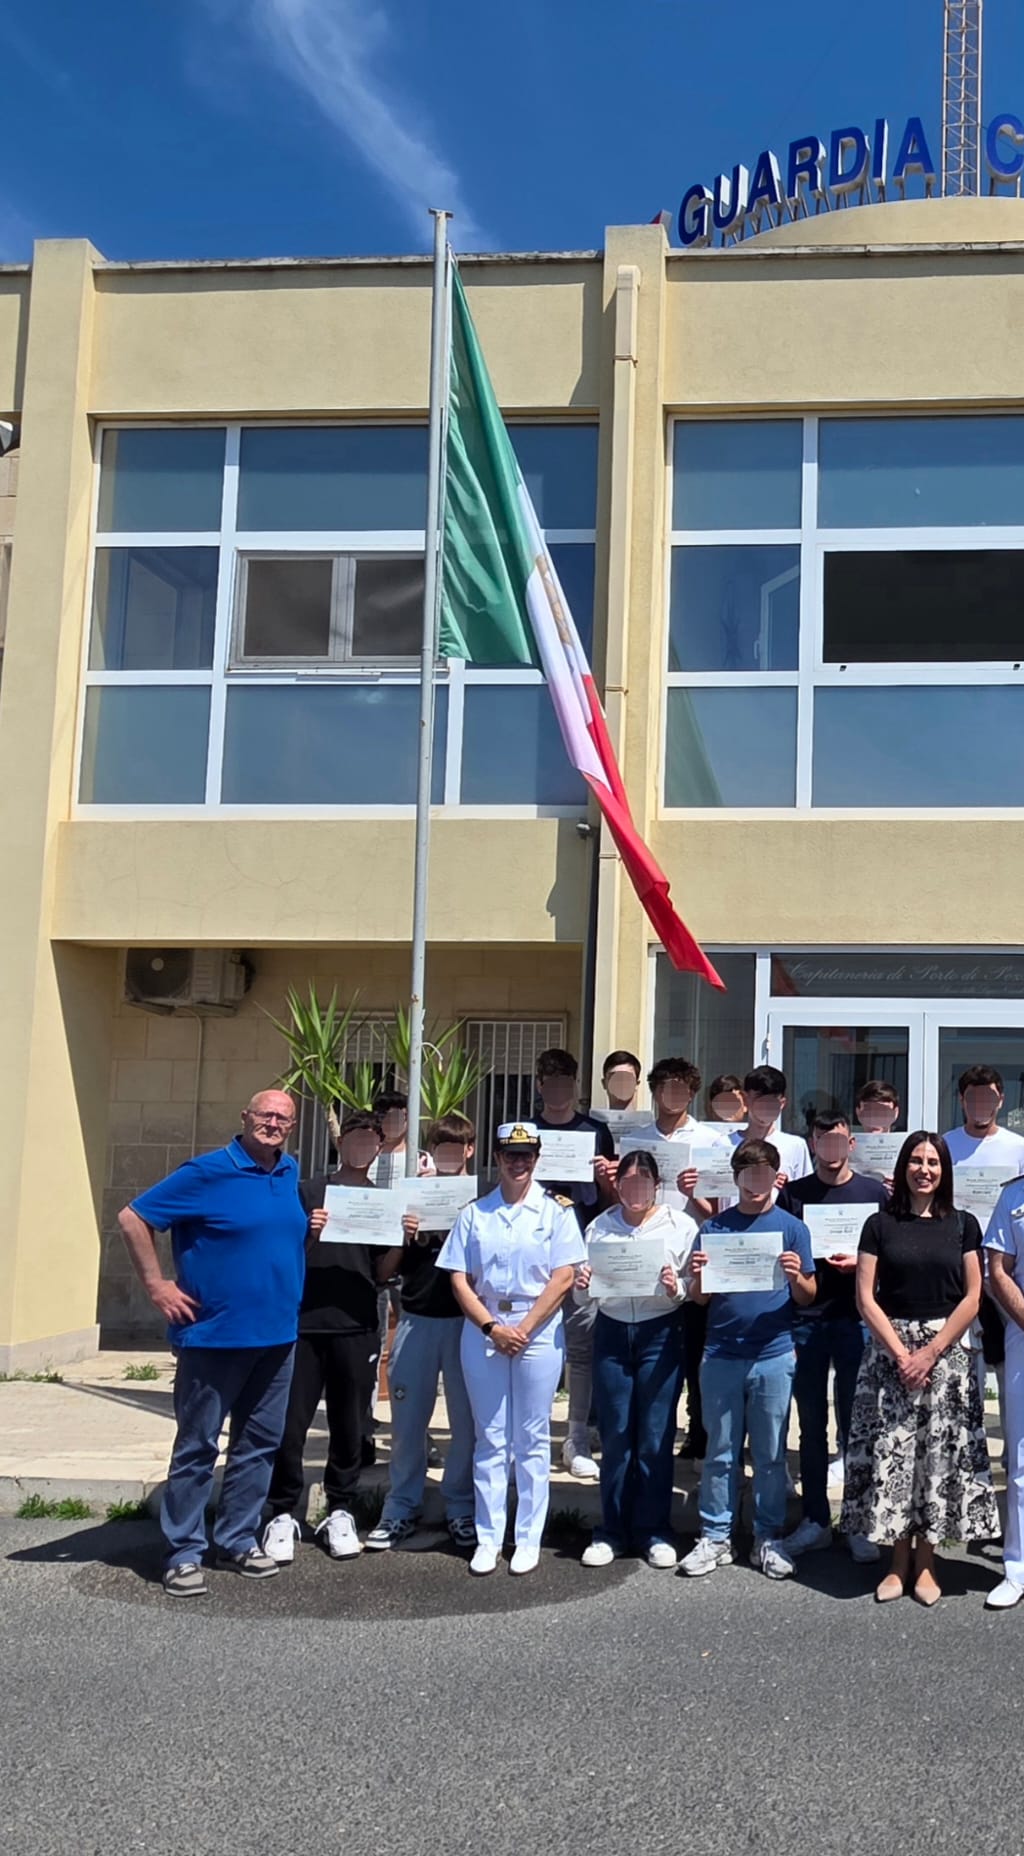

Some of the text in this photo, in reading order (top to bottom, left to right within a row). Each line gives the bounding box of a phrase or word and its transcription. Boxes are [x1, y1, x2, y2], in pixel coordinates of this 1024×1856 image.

[678, 117, 935, 245] GUARDIA
[886, 965, 906, 981] di
[961, 966, 980, 981] di
